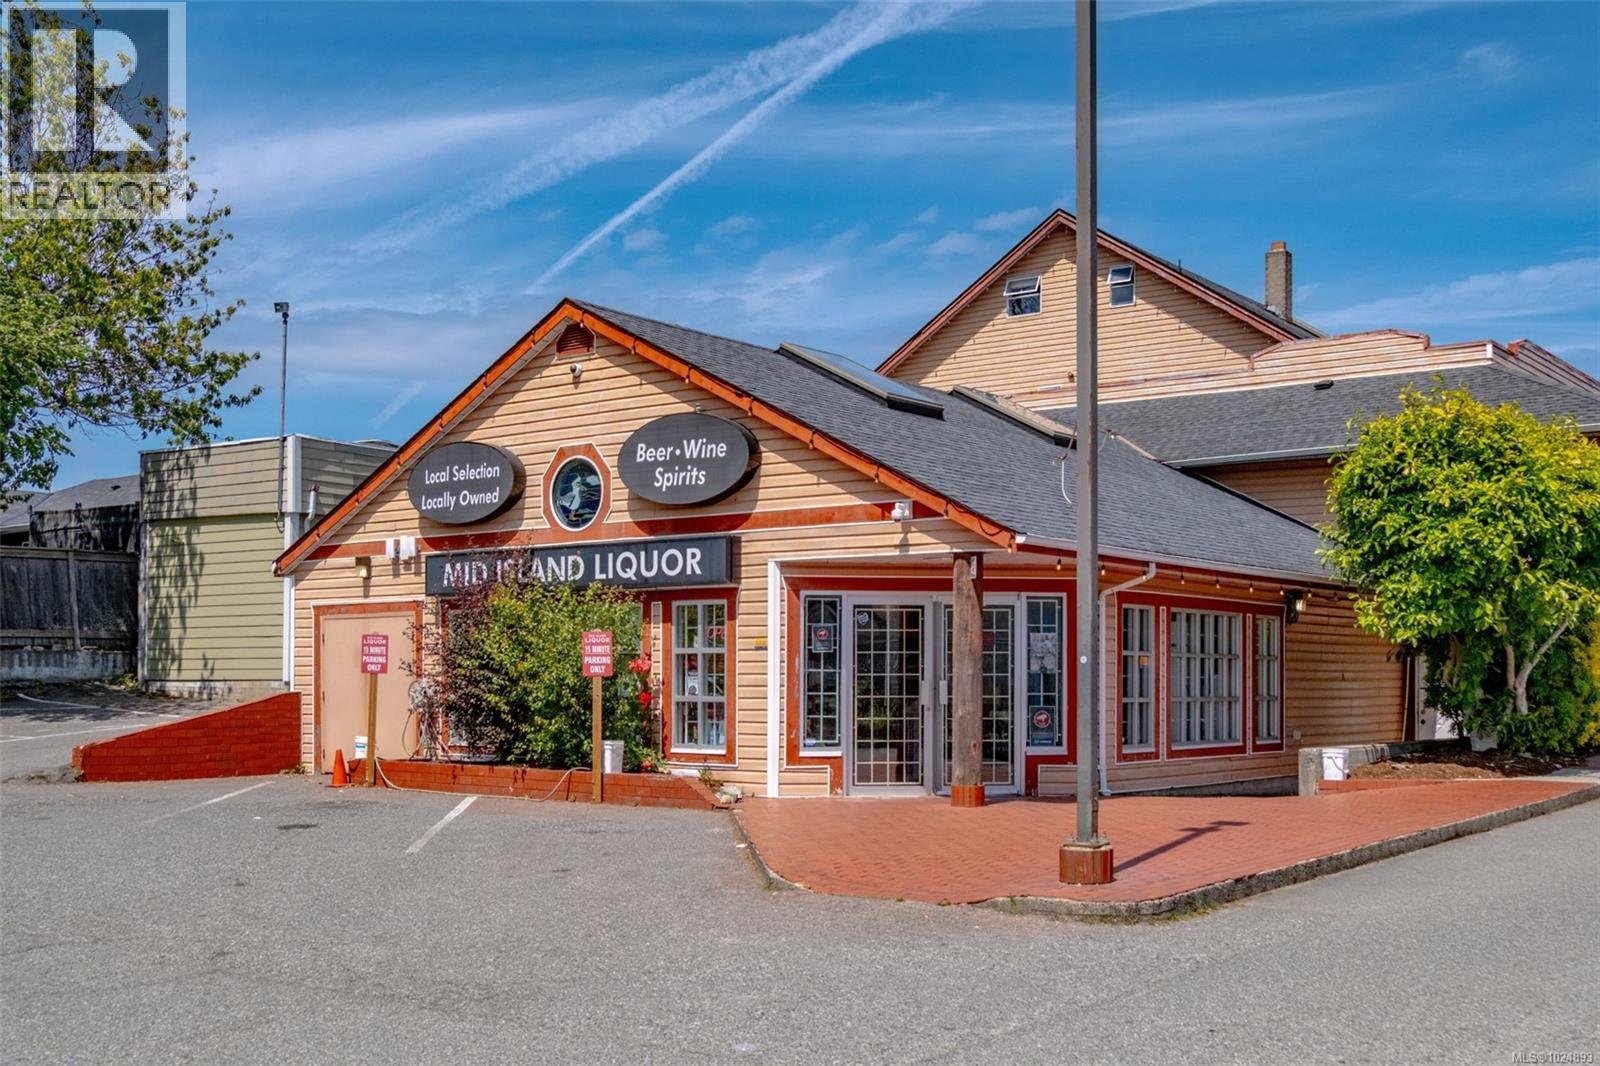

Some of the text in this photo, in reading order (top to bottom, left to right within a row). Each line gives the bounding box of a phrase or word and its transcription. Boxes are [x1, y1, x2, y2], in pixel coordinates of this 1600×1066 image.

[683, 438, 727, 459] Wine
[425, 462, 500, 484] Local Selection
[654, 465, 706, 492] Spirits
[421, 487, 499, 511] Locally Owned
[595, 548, 702, 580] LIQUOR
[592, 645, 611, 654] MINUTE
[584, 656, 611, 665] PARKING
[589, 665, 605, 673] ONLY
